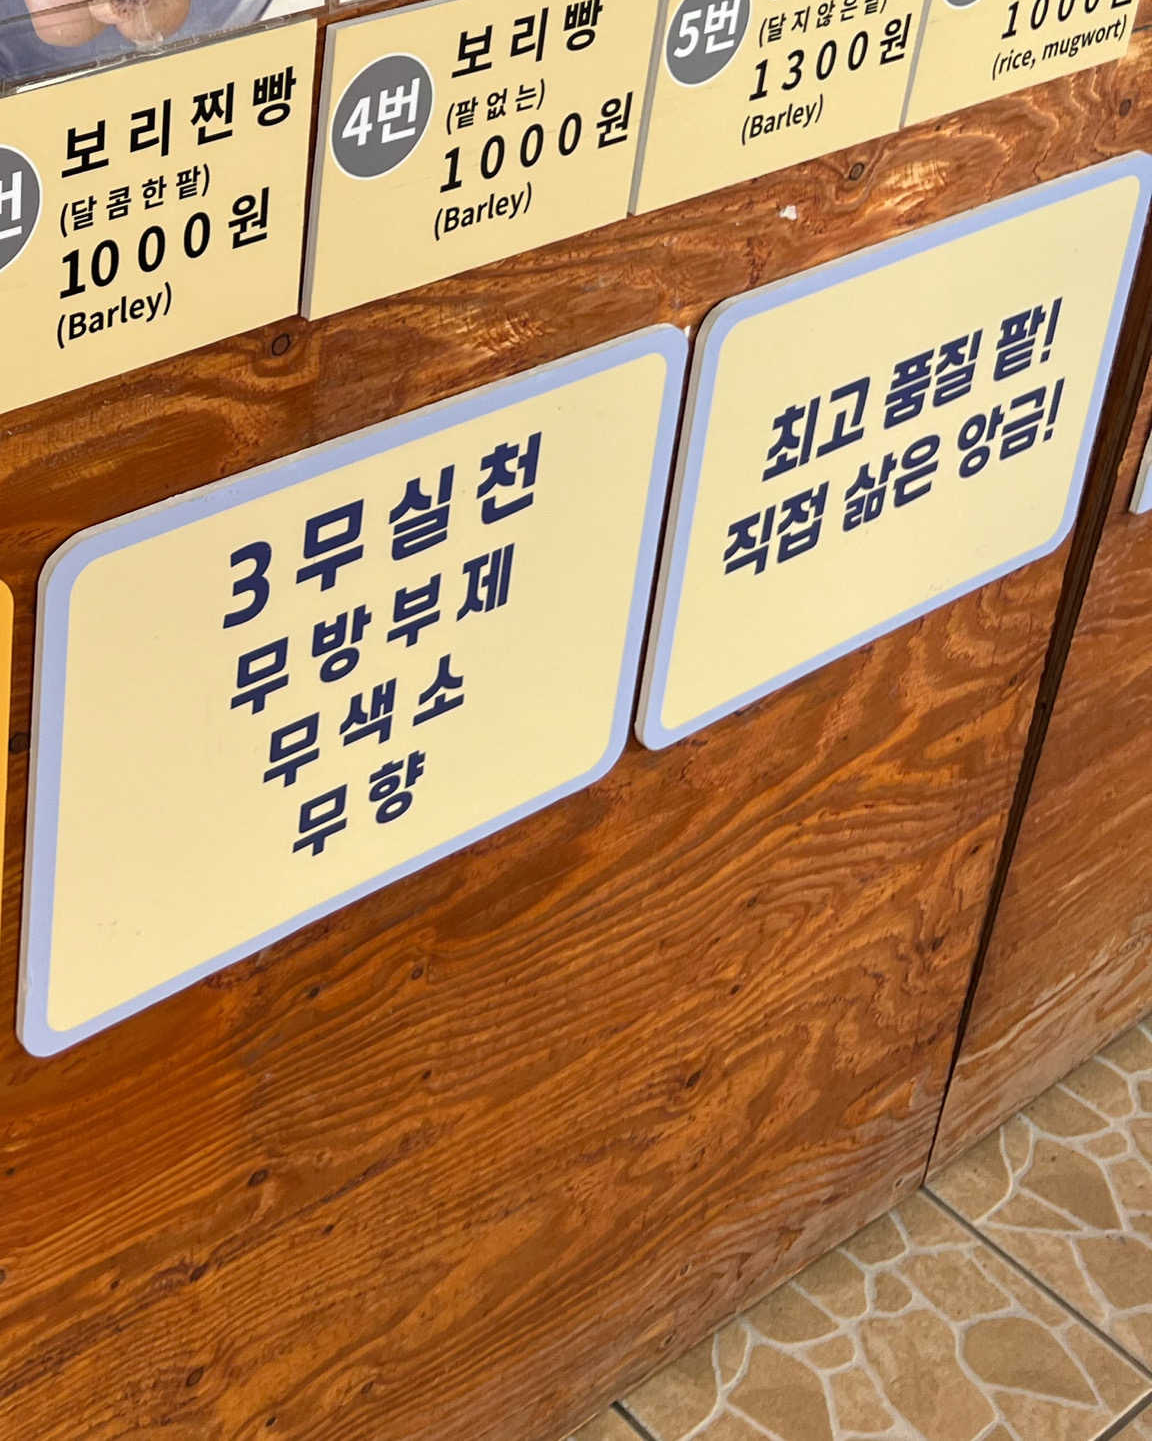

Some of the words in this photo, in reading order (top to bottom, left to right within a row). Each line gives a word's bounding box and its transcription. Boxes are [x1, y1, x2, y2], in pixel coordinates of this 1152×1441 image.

[992, 48, 1036, 81] (rice,
[1042, 14, 1127, 61] mugwort)
[341, 77, 421, 147] 4번
[741, 93, 824, 146] (Barley)
[434, 181, 533, 241] (Barley)
[56, 281, 173, 349] (Barley)
[761, 376, 871, 483] 최고
[883, 328, 983, 430] 품질
[993, 295, 1063, 382] 팥!
[723, 480, 830, 576] 직접
[842, 434, 941, 533] 삶은
[957, 377, 1066, 479] 앙금!
